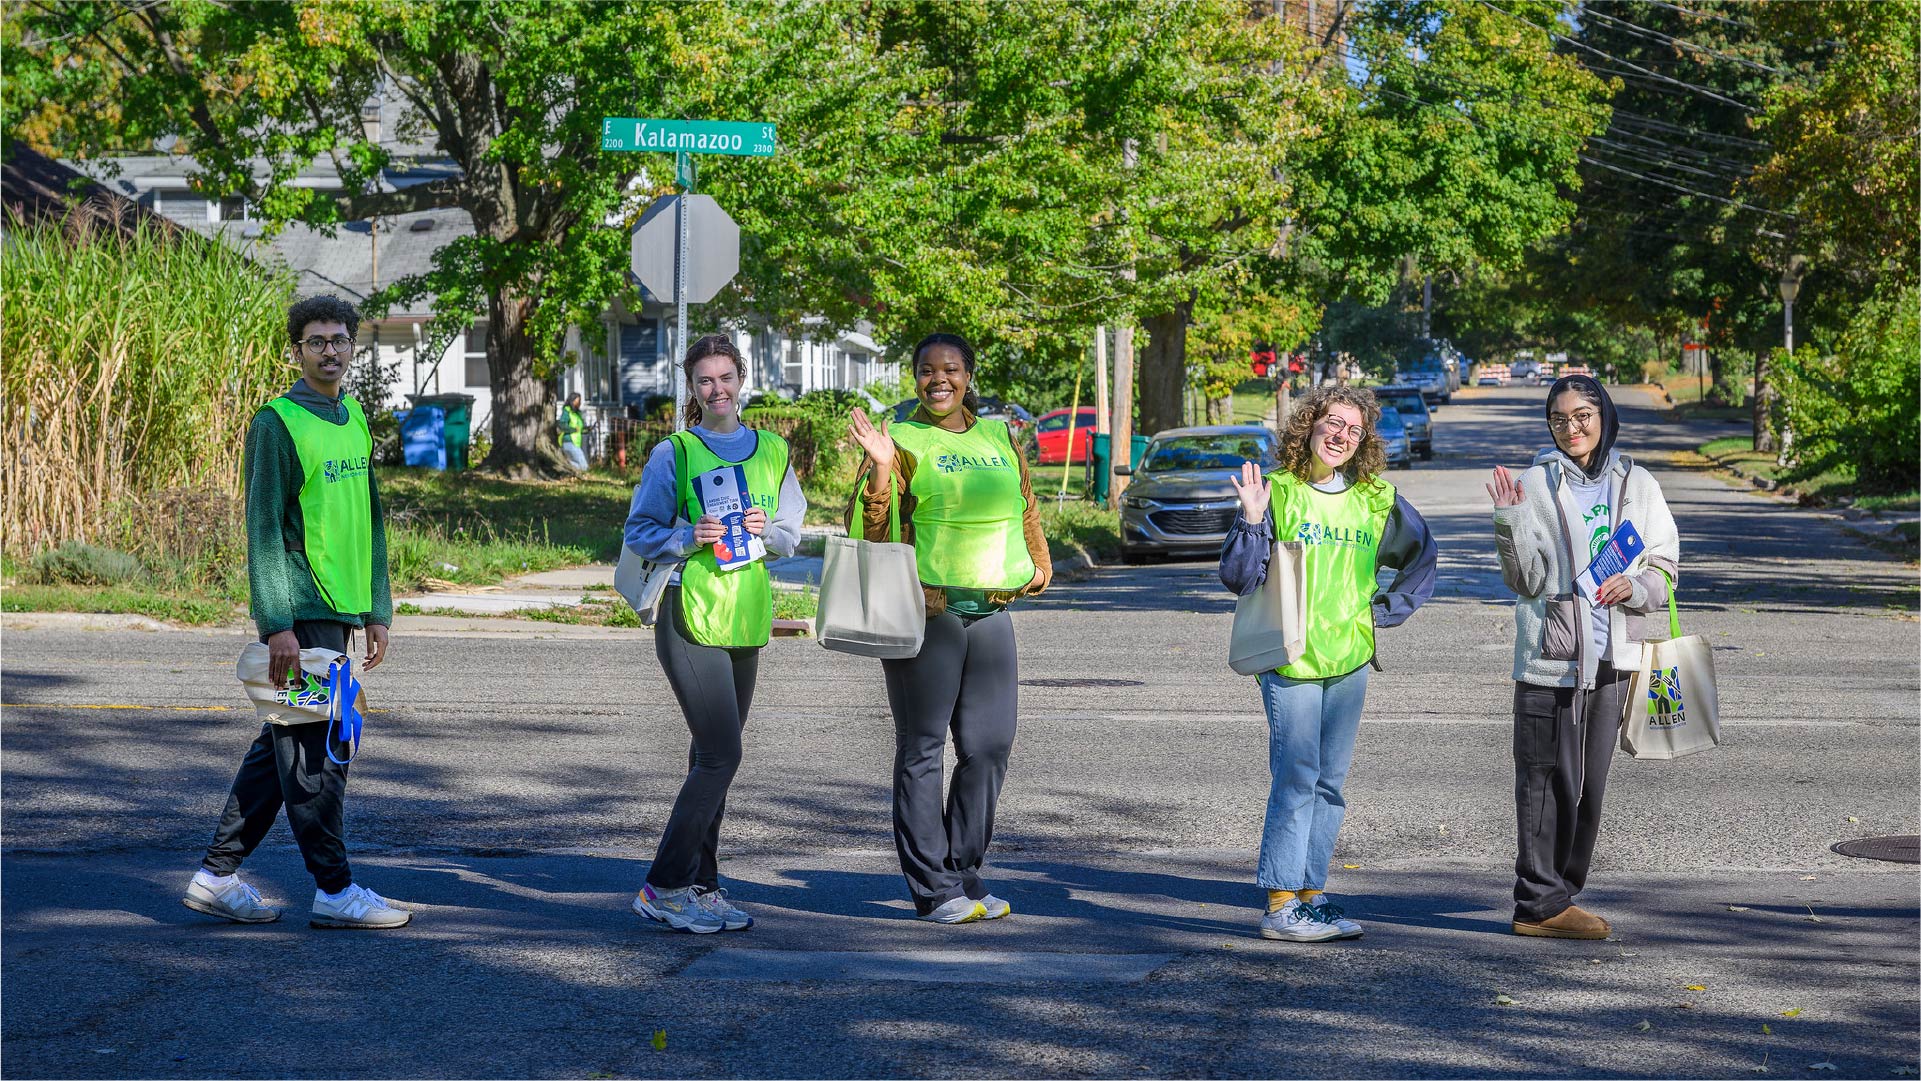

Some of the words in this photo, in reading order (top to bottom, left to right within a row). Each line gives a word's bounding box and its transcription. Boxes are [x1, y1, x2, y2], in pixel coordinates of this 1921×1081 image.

[605, 121, 611, 135] E
[635, 123, 742, 150] Kalamazoo
[762, 126, 774, 141] St
[605, 138, 623, 148] 2200
[753, 144, 773, 153] 2300
[340, 456, 367, 472] ALLE
[751, 493, 774, 509] LEN
[1323, 525, 1372, 547] ALLEN
[1649, 712, 1685, 725] ALLEN
